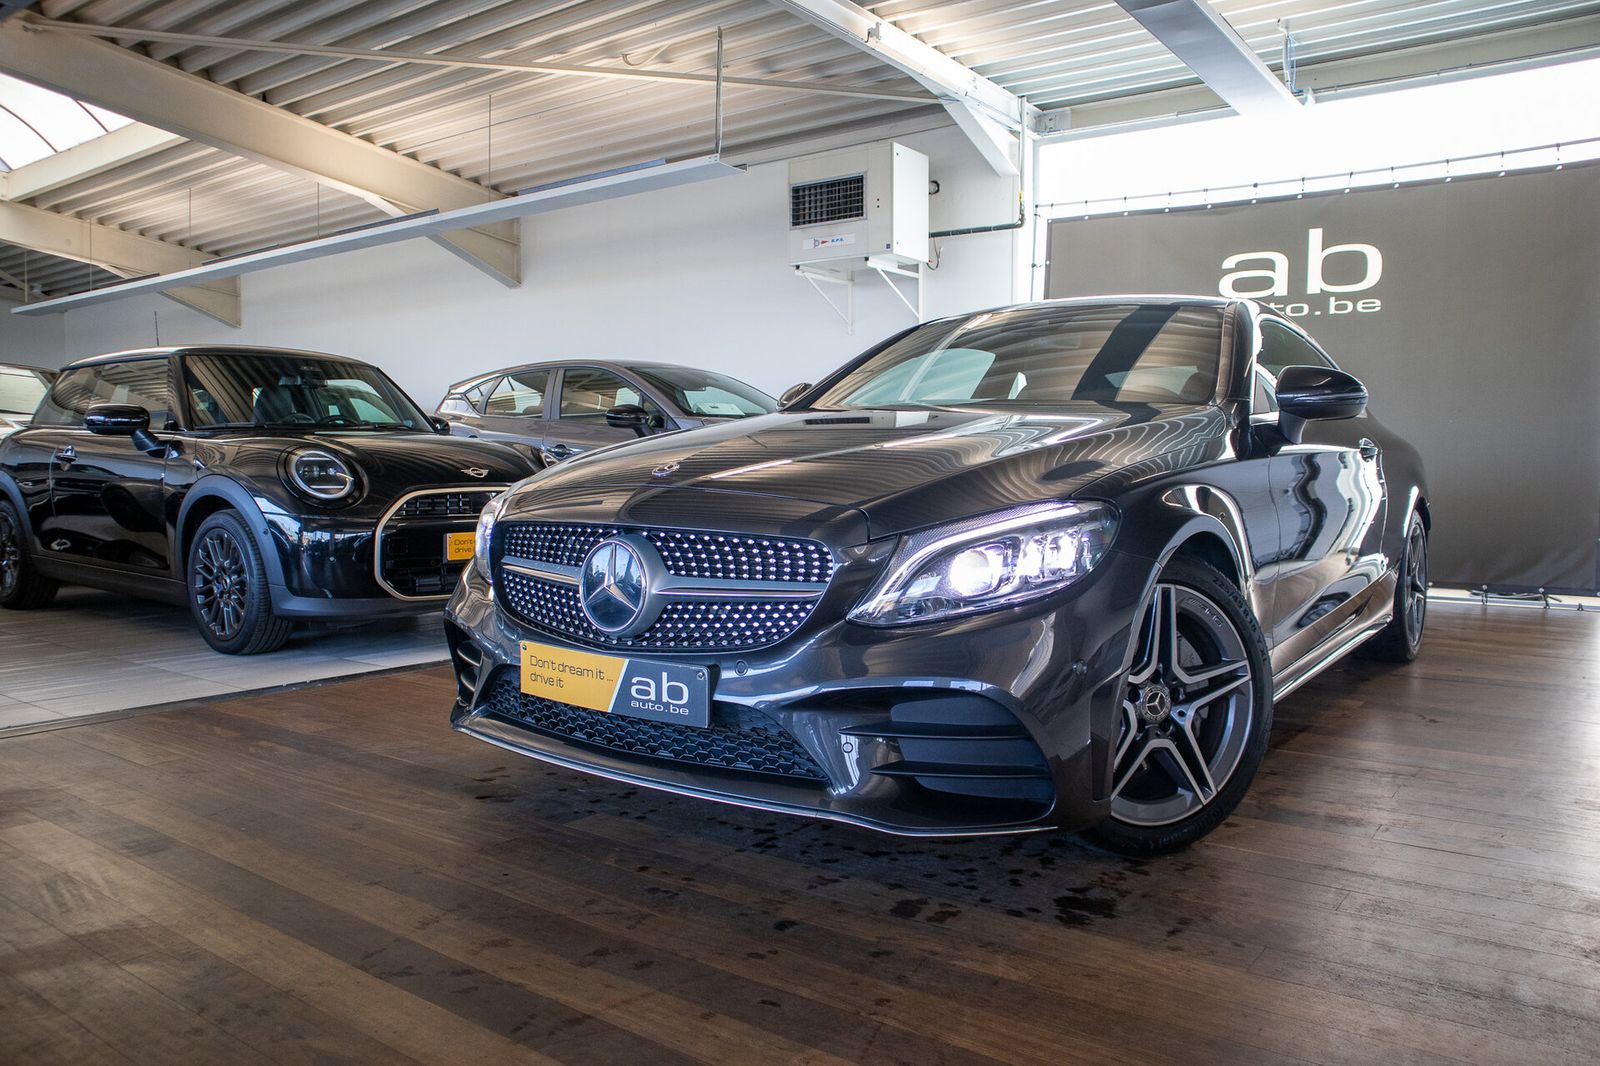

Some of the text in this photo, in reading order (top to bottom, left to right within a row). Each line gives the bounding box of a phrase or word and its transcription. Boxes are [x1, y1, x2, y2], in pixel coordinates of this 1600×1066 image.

[1218, 228, 1383, 299] ab
[1269, 297, 1382, 317] to.be
[529, 655, 556, 668] Don't
[557, 663, 594, 679] dream
[529, 671, 564, 689] drive it
[630, 671, 689, 704] ab
[630, 700, 689, 714] auto.be
